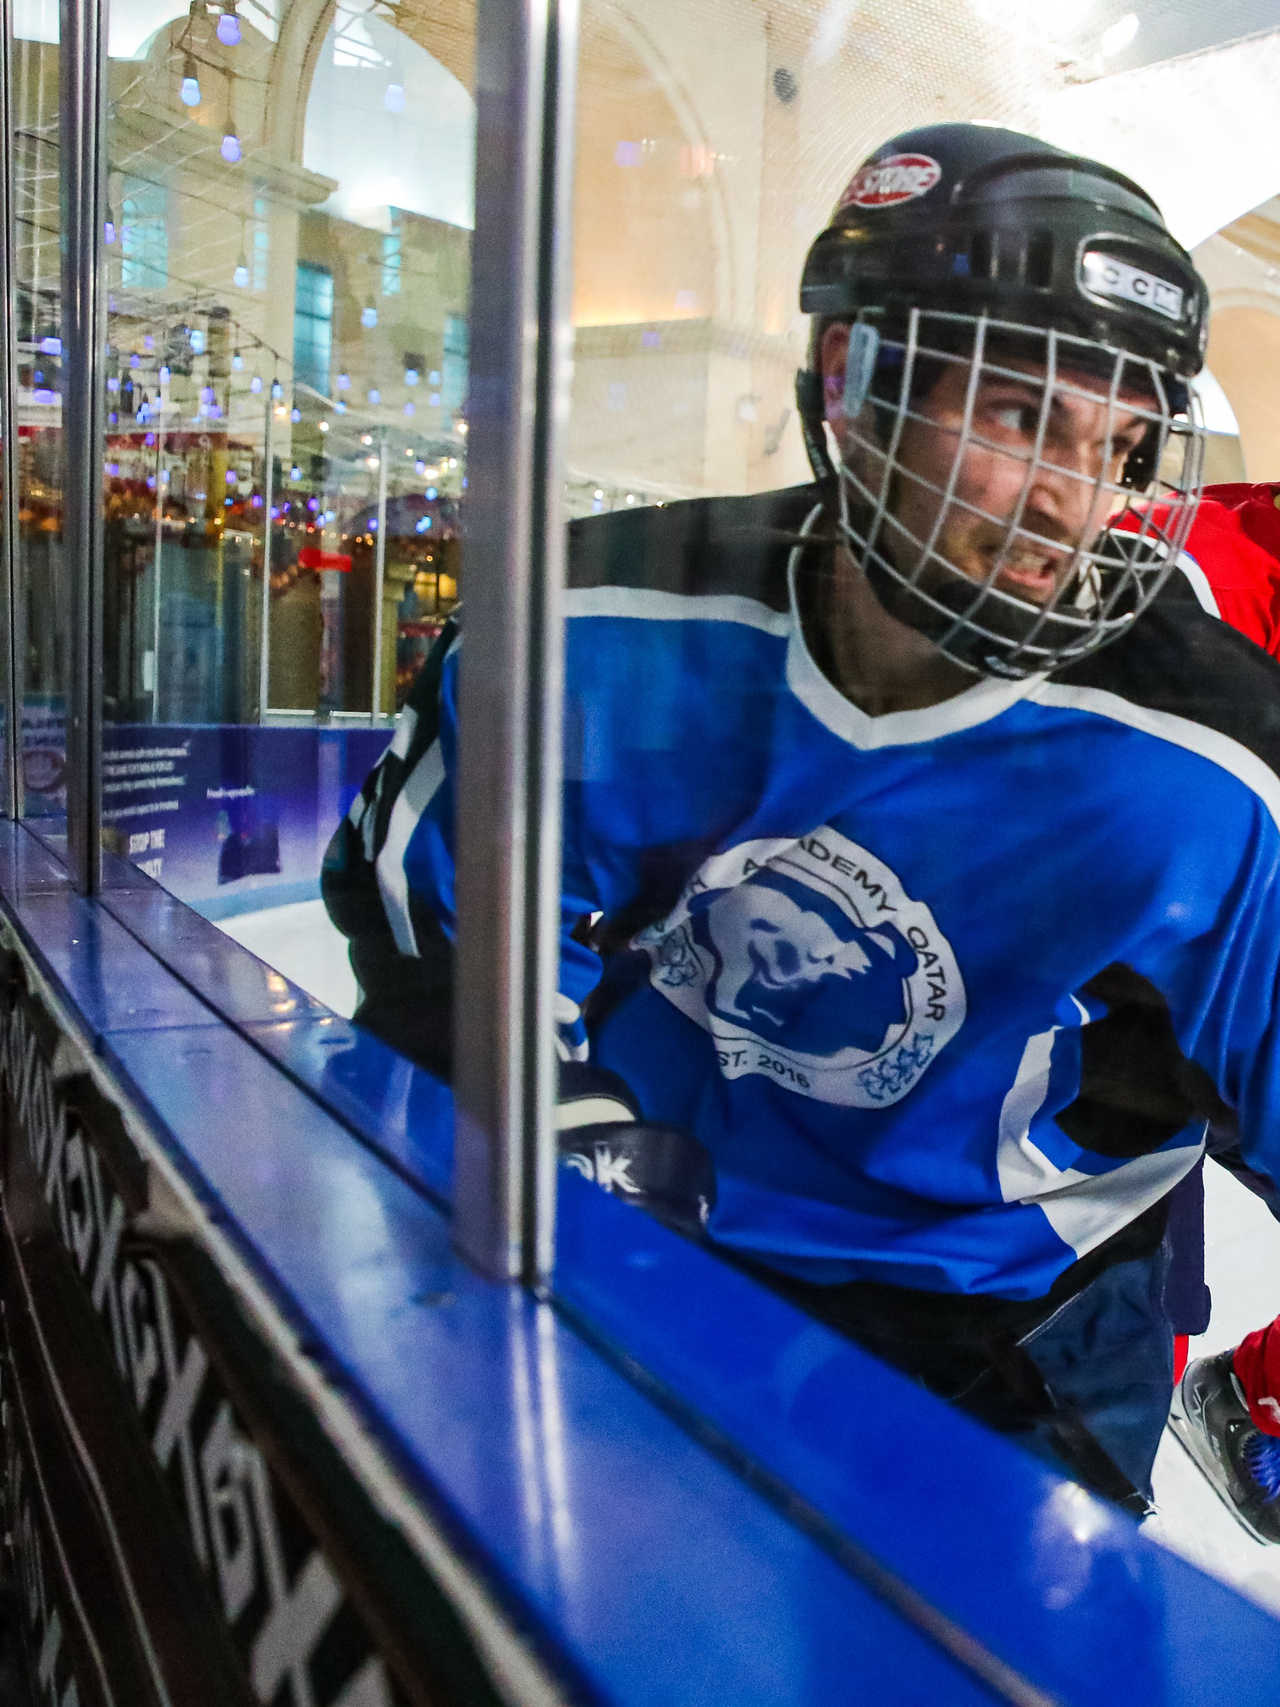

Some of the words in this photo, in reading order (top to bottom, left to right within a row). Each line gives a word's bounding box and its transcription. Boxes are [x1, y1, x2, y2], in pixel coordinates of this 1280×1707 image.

[742, 838, 898, 912] ADEMY
[906, 926, 947, 1021] QATAR
[717, 1050, 747, 1068] ST.
